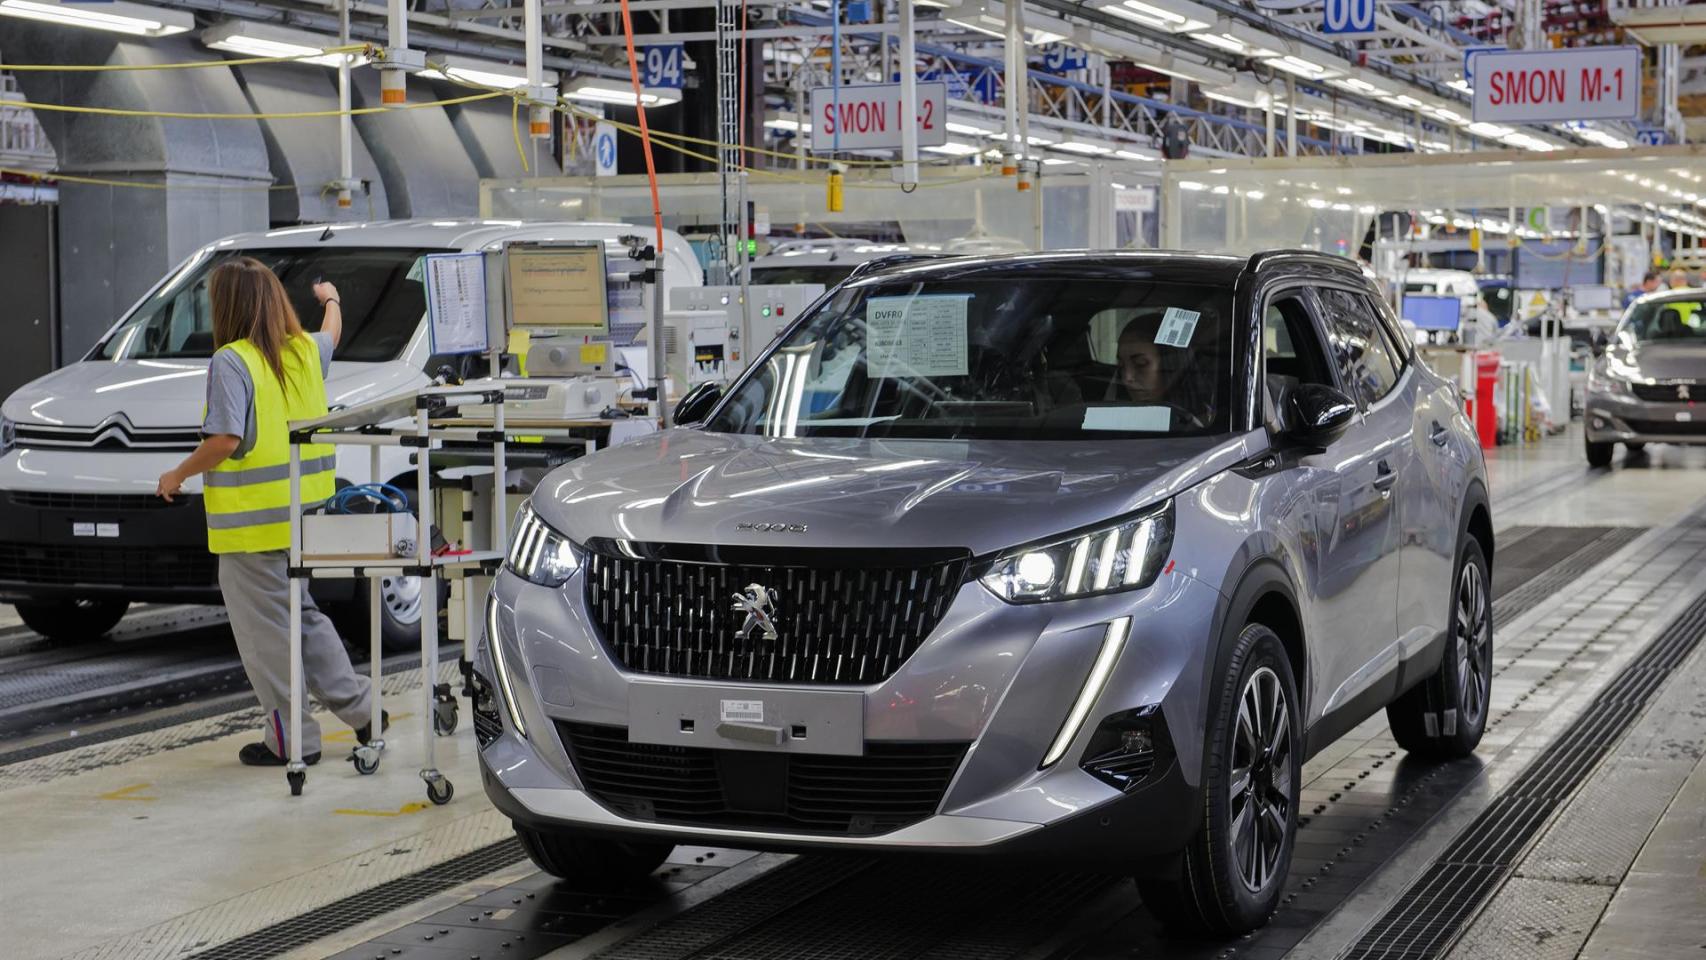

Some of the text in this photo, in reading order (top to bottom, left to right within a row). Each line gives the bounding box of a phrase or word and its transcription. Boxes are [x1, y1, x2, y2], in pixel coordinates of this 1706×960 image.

[647, 47, 680, 86] 94
[1489, 67, 1624, 106] SMON M-1
[823, 99, 933, 135] SMON -2
